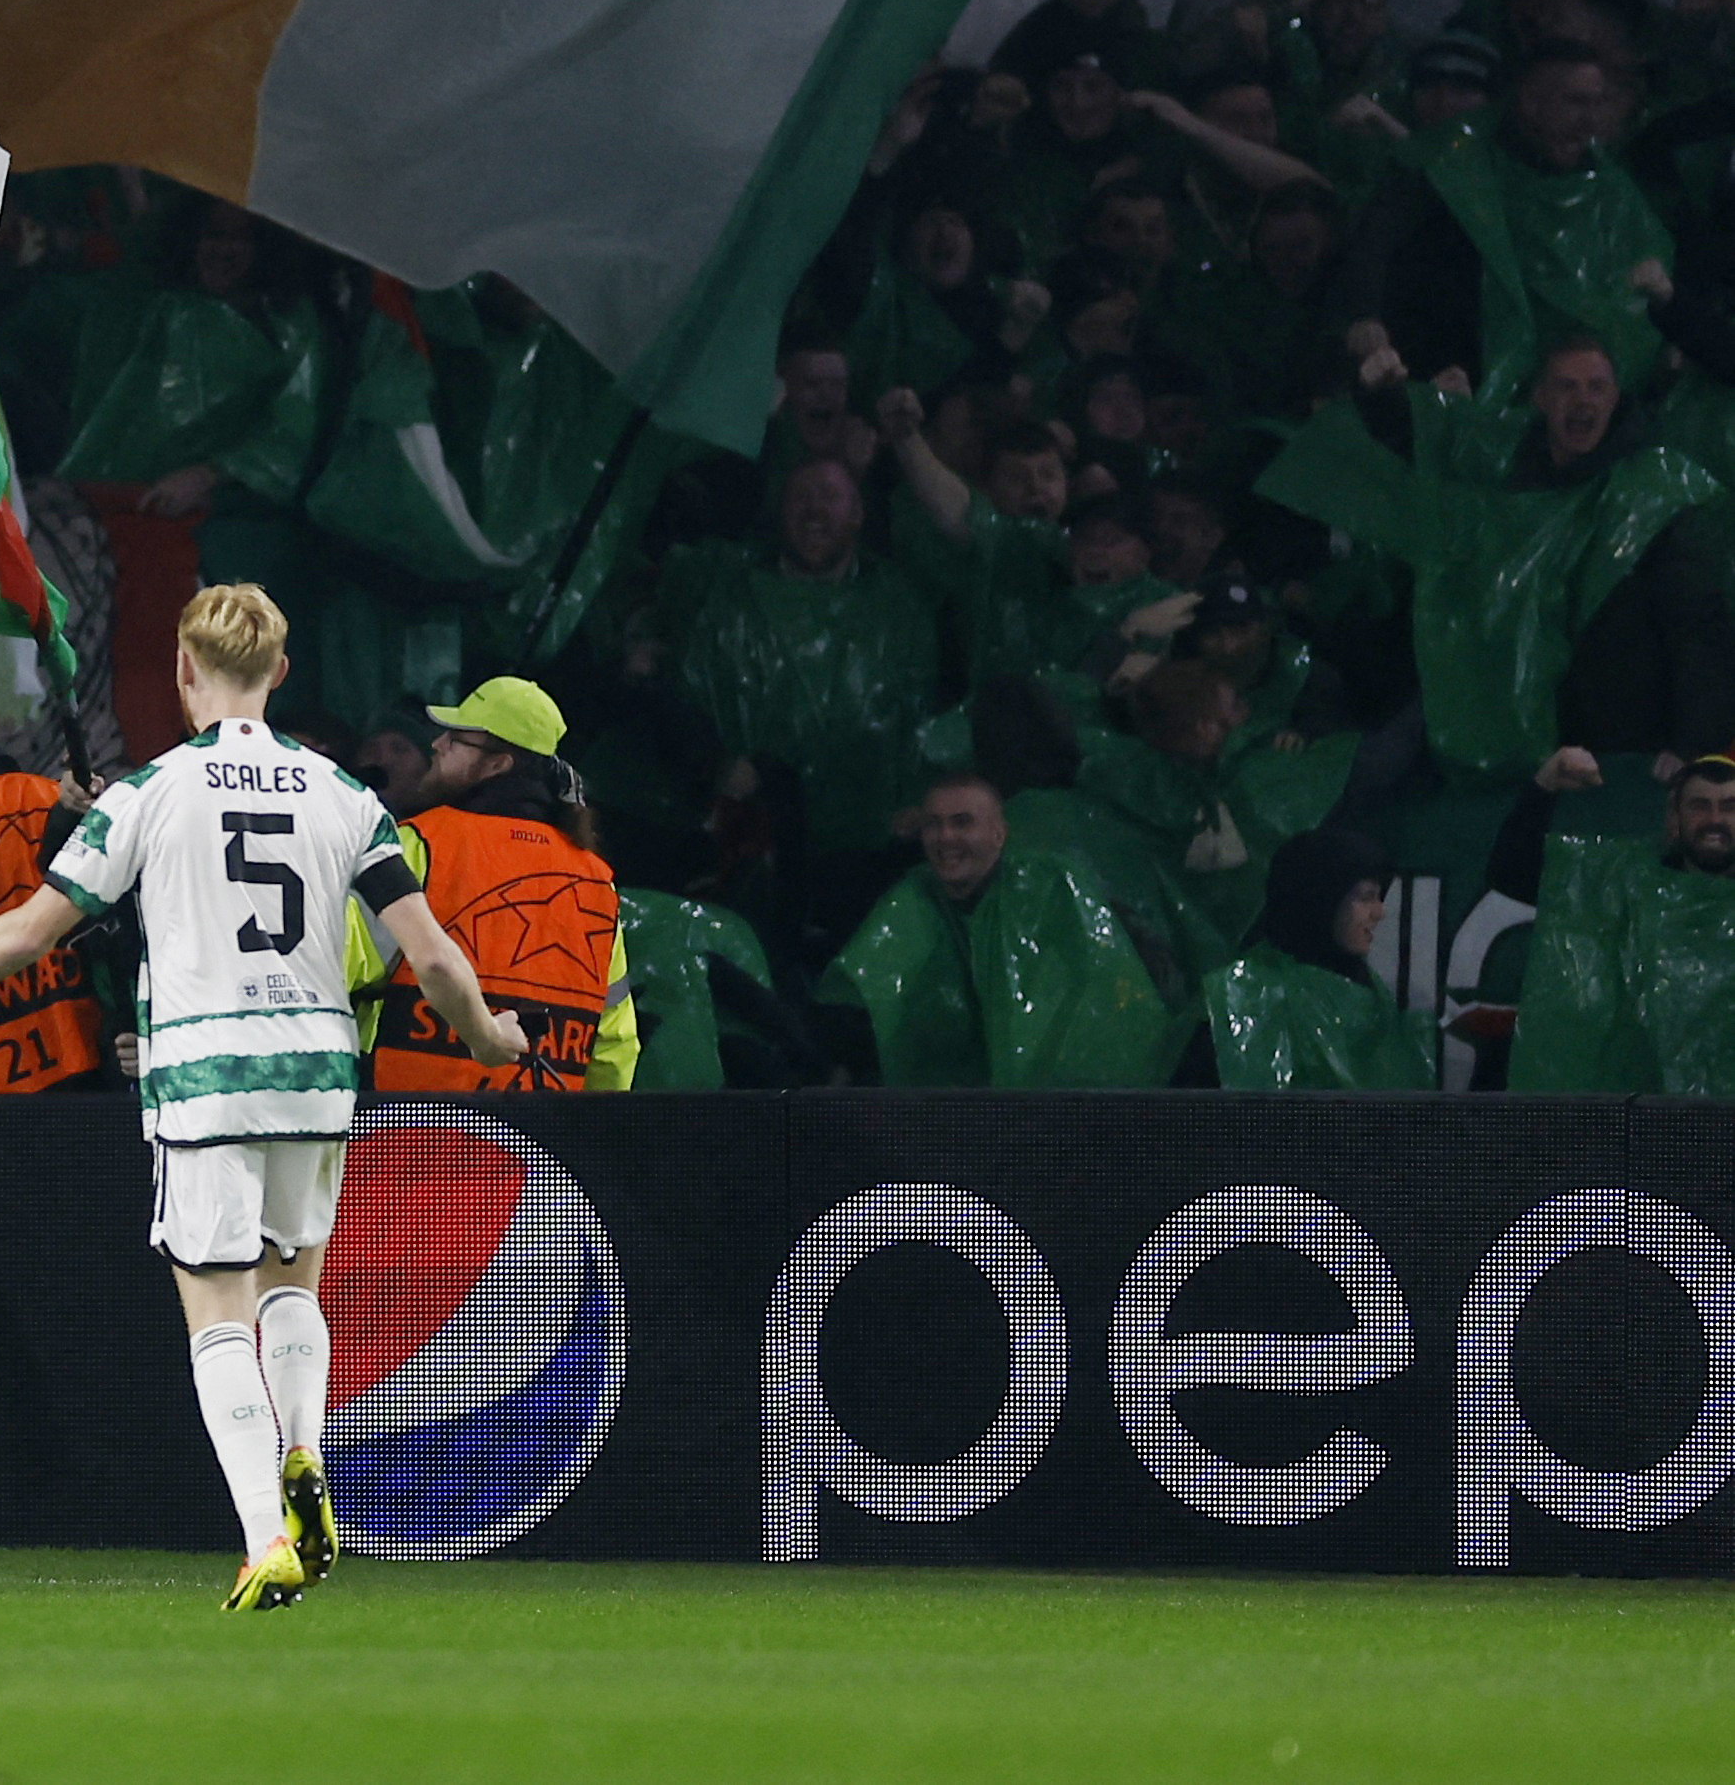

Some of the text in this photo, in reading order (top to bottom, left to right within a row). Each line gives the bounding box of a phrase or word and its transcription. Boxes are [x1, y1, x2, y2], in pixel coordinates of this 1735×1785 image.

[205, 762, 308, 794] SCALES
[221, 811, 305, 956] 5
[761, 1181, 1735, 1566] pep
